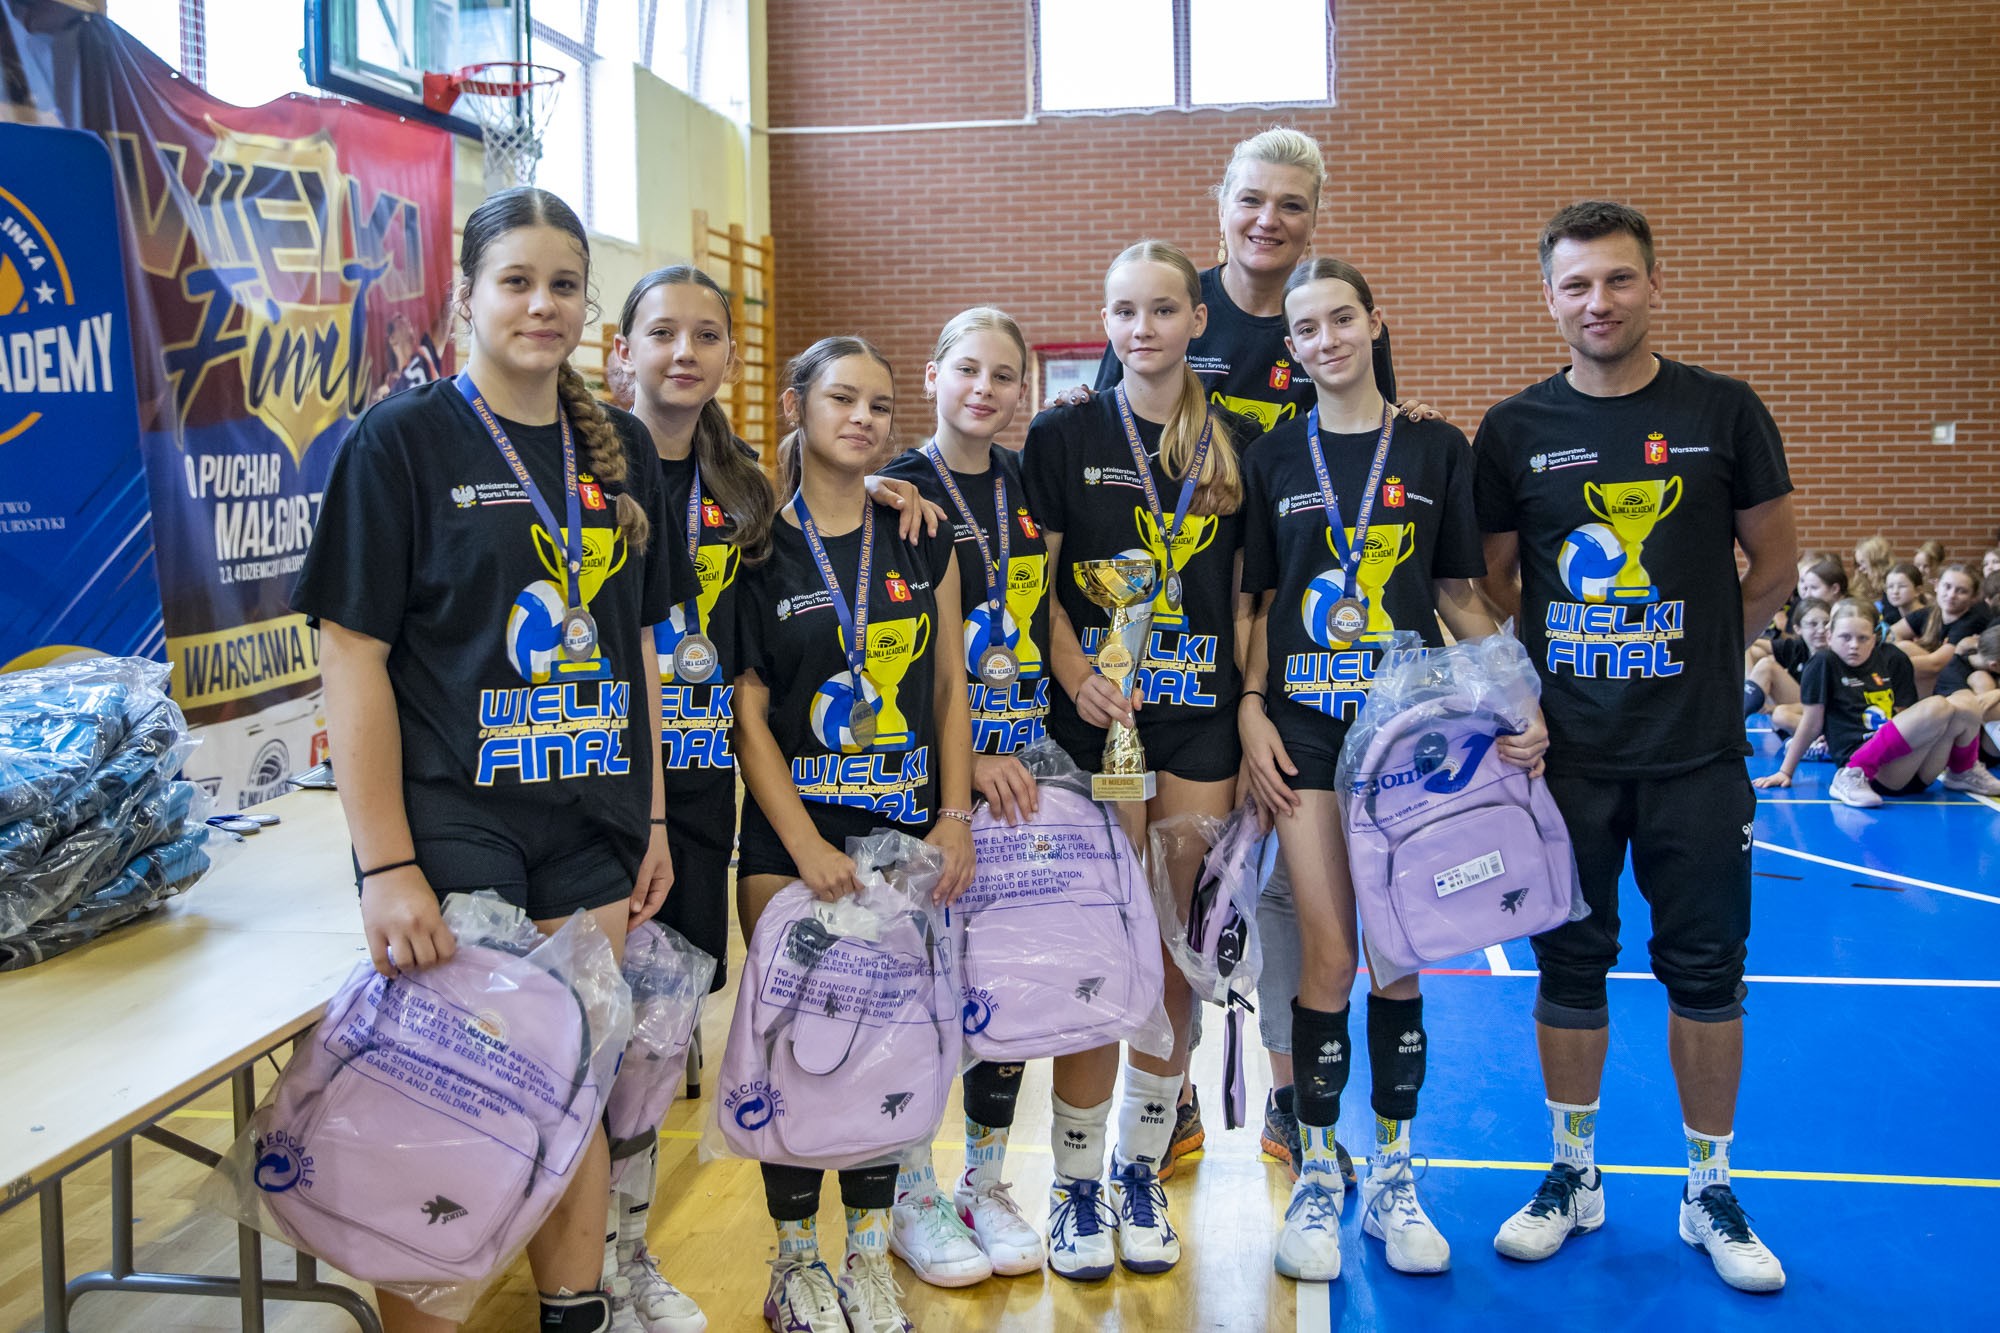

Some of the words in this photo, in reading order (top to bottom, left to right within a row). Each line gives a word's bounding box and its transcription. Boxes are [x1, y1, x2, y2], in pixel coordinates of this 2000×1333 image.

[1188, 355, 1222, 363] Ministerstwo
[1208, 362, 1231, 371] Turystyki
[473, 397, 500, 438] Warszawa,
[498, 435, 531, 483] 5-7.09.2025
[1670, 445, 1709, 454] Warszawa
[1547, 448, 1585, 458] Ministerstwo
[1548, 457, 1567, 465] Sportu
[1571, 452, 1598, 461] Turystyki
[200, 453, 281, 498] PUCHAR
[1102, 467, 1136, 475] Ministerstwo
[1102, 473, 1120, 481] Sportu
[1124, 475, 1142, 485] Turysty
[476, 483, 518, 491] Ministerstwo
[478, 491, 501, 499] Sportu
[504, 489, 528, 498] Turysty
[1317, 467, 1335, 507] 5-7.09.2025
[1356, 511, 1369, 540] WIELKI
[1376, 438, 1389, 464] PUCHAR
[1290, 500, 1308, 508] Sportu
[1631, 503, 1655, 514] ACADEMY
[0, 517, 66, 533] URYSTYKI
[215, 491, 323, 561] MAŁGORZ
[804, 518, 821, 553] Warszawa,
[818, 552, 838, 590] 5-7.09.2025
[860, 545, 870, 570] PUCHAR
[698, 570, 719, 582] CADEMY
[791, 590, 829, 603] Ministerstwo
[857, 576, 868, 605] TURNIEJU
[793, 601, 812, 610] Sportu
[1545, 600, 1685, 634] WIELKI
[854, 626, 865, 650] WIELKI
[184, 624, 306, 698] WARSZAWA
[1546, 639, 1684, 678] FINAŁ
[478, 681, 630, 728] WIELKI
[661, 684, 734, 720] ELK
[1288, 689, 1368, 721] FIN
[475, 728, 630, 787] FINAŁ
[662, 728, 733, 769] NAŁ
[792, 746, 929, 787] WIELKI
[984, 845, 1004, 853] ESTE
[1006, 843, 1027, 851] TIPO
[1068, 841, 1095, 851] FUREA
[991, 836, 999, 844] EL
[1052, 832, 1084, 841] ASFIXIA,
[1002, 853, 1014, 861] DE
[978, 873, 1014, 883] DANGER
[1016, 871, 1028, 879] OF
[979, 881, 1015, 892] SHOULD
[1017, 880, 1029, 888] BE
[1031, 876, 1053, 886] KEPT
[965, 892, 996, 903] BABIES
[998, 891, 1016, 899] AND
[1019, 886, 1063, 896] CHILDREN
[769, 985, 795, 999] FROM
[772, 977, 792, 988] THIS
[817, 987, 853, 1004] SHOULD
[854, 996, 866, 1005] BE
[776, 967, 789, 977] TO
[790, 972, 818, 986] AVOID
[819, 978, 857, 995] DANGER
[437, 1007, 449, 1019] EL
[351, 1013, 368, 1028] TO
[362, 1023, 396, 1048] AVOID
[395, 1041, 439, 1072] DANGER
[439, 1064, 454, 1078] OF
[421, 1013, 449, 1034] ESTE
[450, 1027, 475, 1046] TIPO
[487, 1049, 523, 1075] BOLSA
[437, 1035, 452, 1048] DE
[452, 1042, 488, 1067] BEBES
[345, 1023, 369, 1042] THIS
[390, 1052, 434, 1082] SHOULD
[433, 1074, 450, 1089] BE
[449, 1081, 477, 1103] KEPT
[477, 1096, 507, 1118] AWAY
[364, 1052, 406, 1082] BABIES
[404, 1074, 429, 1094] AND
[428, 1083, 483, 1121] CHILDREN.
[724, 1081, 785, 1117] RECICABLE
